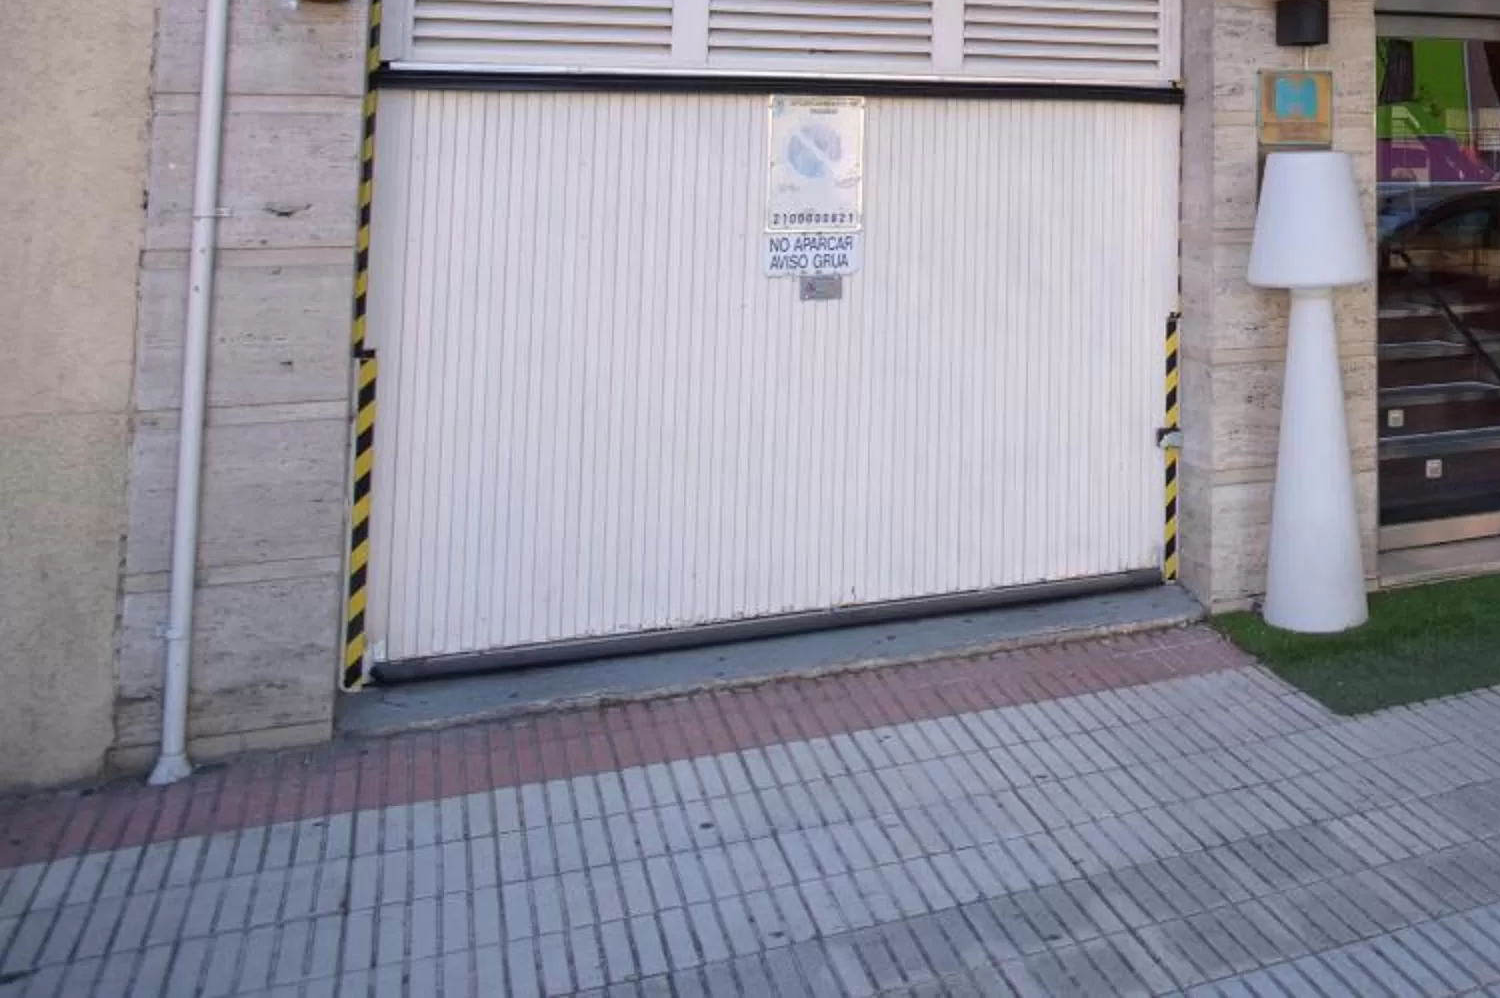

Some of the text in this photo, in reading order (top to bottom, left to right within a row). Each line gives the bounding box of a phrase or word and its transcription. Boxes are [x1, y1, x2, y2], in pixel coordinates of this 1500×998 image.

[769, 234, 853, 253] NO APARCAR
[769, 252, 849, 271] AVISO GRUA
